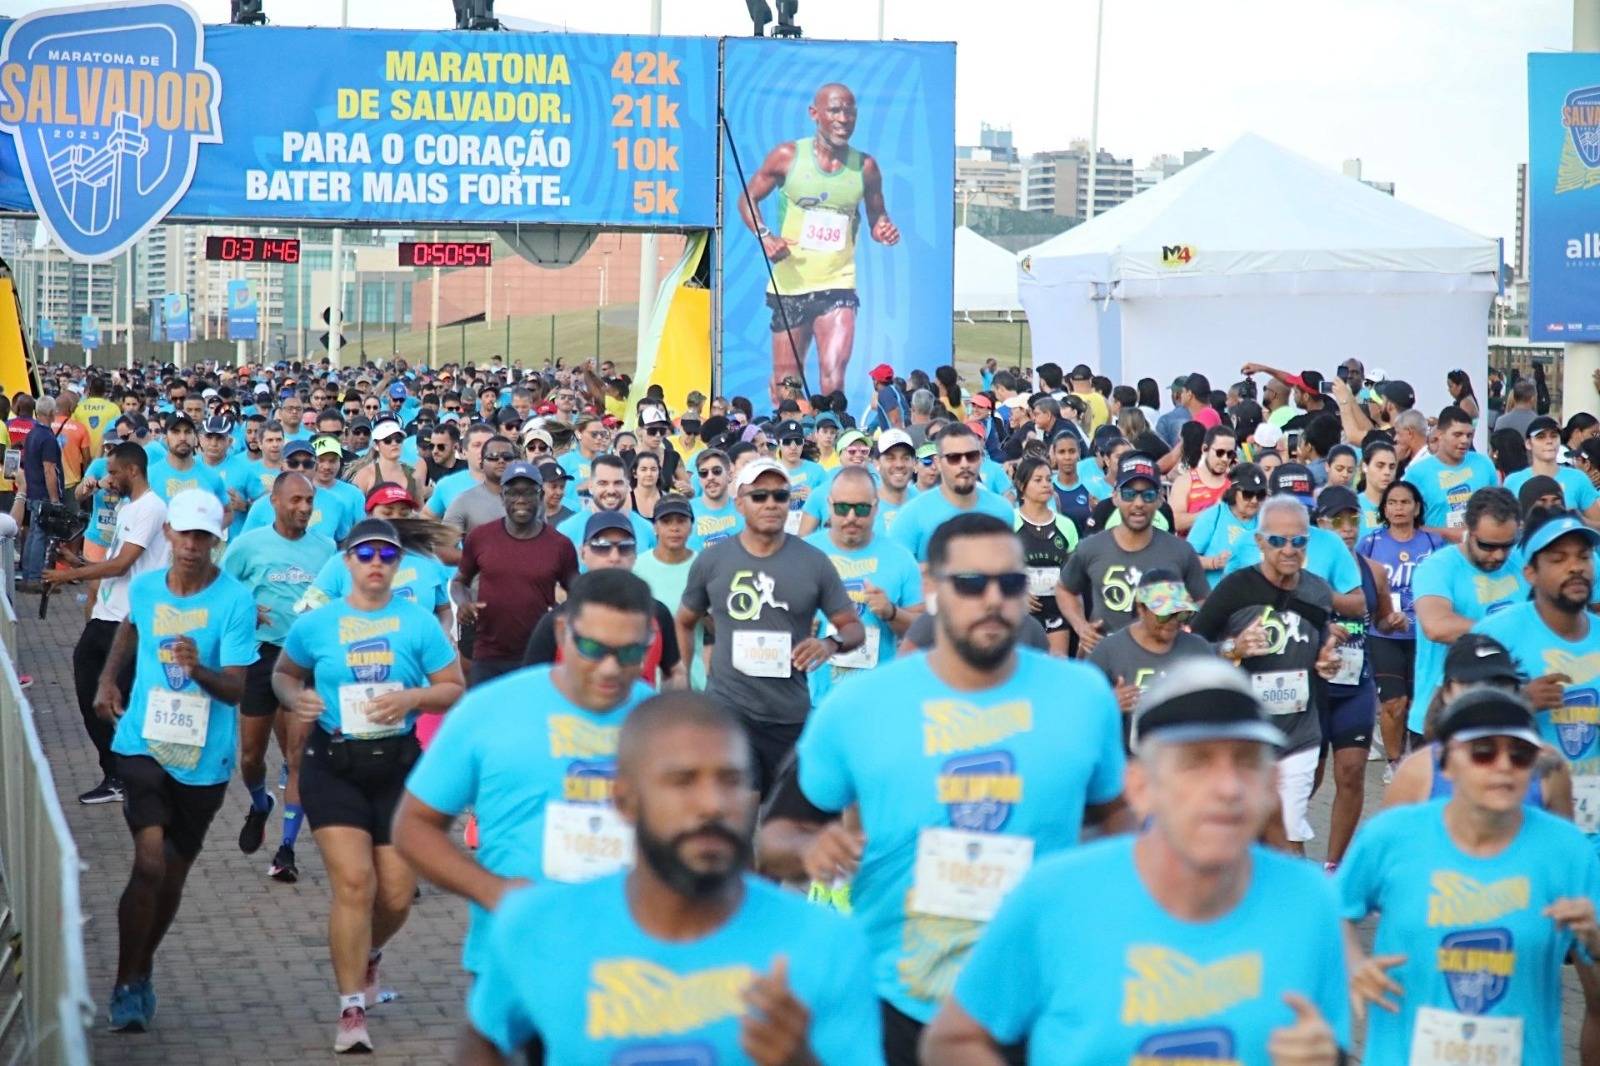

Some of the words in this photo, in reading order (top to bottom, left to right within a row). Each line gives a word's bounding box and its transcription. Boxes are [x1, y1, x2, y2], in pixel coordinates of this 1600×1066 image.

[48, 51, 136, 66] MARATONA
[140, 55, 160, 67] DE
[385, 51, 570, 85] MARATONA
[611, 51, 681, 85] 42k
[1, 62, 211, 132] SALVADOR
[337, 88, 380, 120] DE
[391, 90, 571, 124] SALVADOR.
[611, 95, 681, 128] 21k
[53, 129, 100, 140] 2023
[283, 131, 371, 164] PARA
[382, 134, 404, 166] O
[415, 129, 571, 174] CORAÇÃO
[613, 137, 680, 171] 10k
[246, 170, 351, 201] BATER
[362, 172, 449, 203] MAIS
[459, 174, 571, 206] FORTE.
[633, 181, 679, 214] 5k
[806, 224, 841, 242] 3439
[221, 238, 299, 262] 0:31:46
[413, 244, 490, 266] 0:50:54
[1162, 245, 1192, 263] M4
[1262, 688, 1297, 702] 50050
[154, 710, 194, 728] 51285
